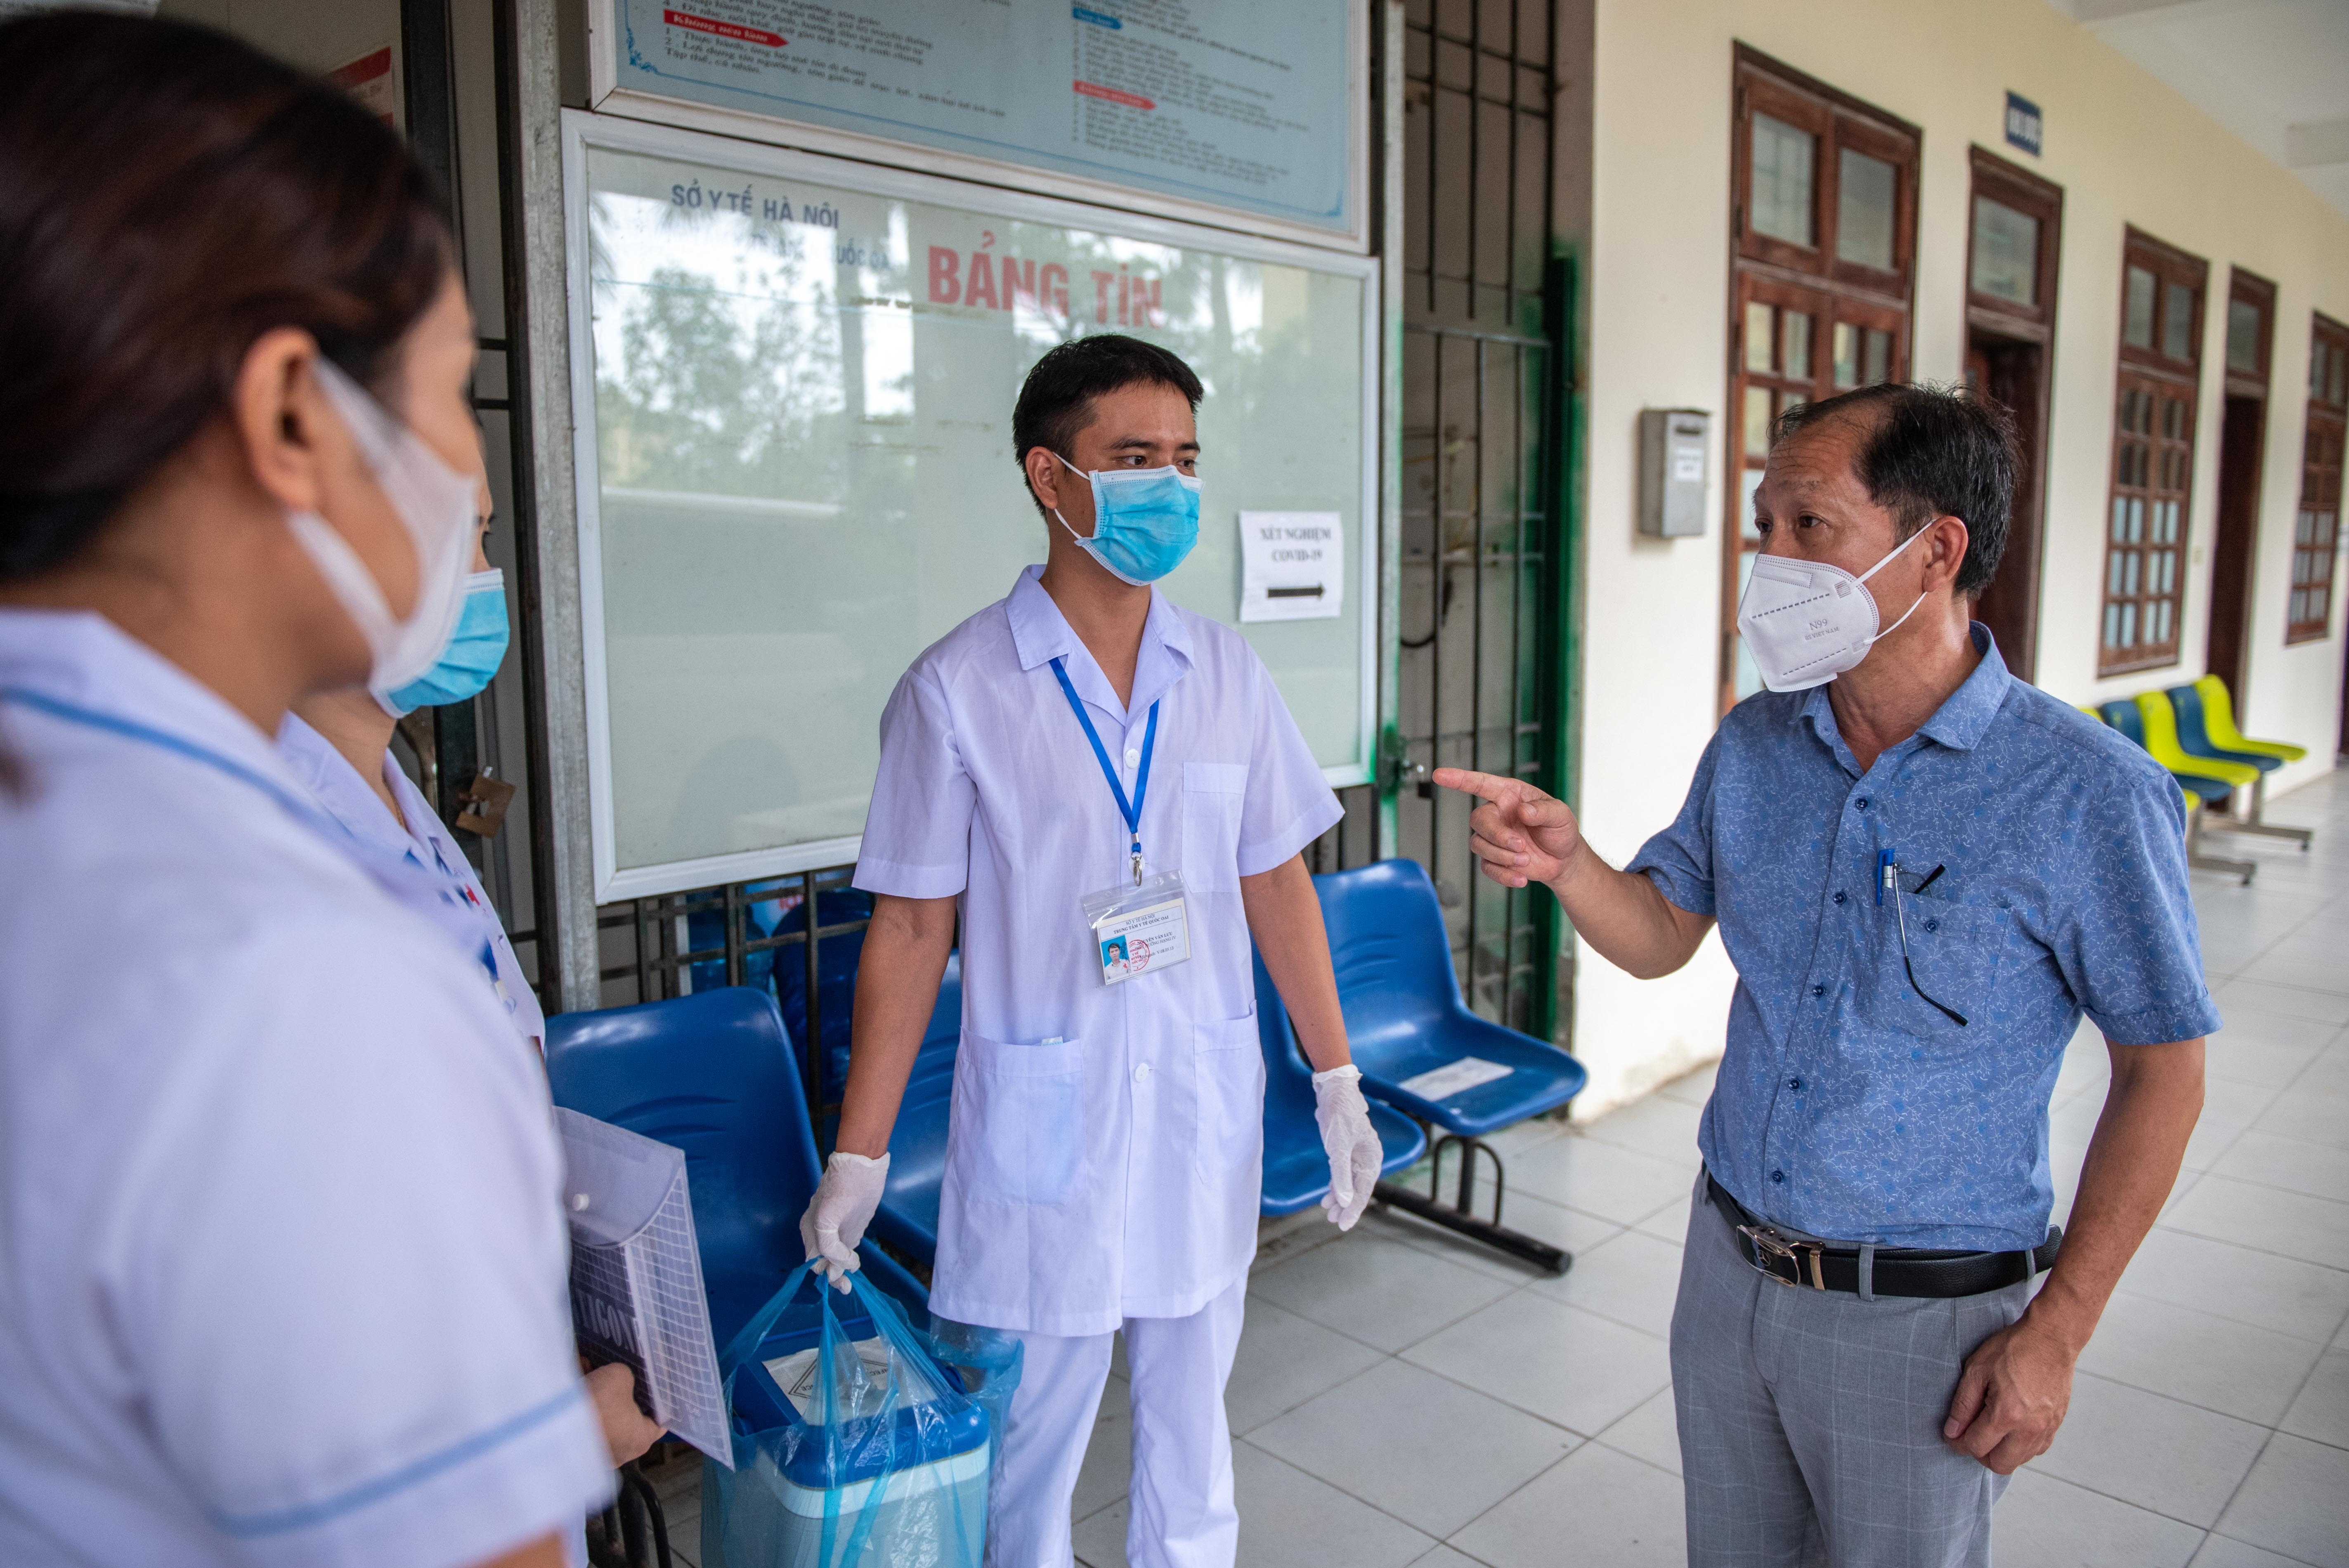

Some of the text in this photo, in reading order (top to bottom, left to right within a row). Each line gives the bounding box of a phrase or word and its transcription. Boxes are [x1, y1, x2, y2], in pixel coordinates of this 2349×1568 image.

[708, 189, 723, 211] Y
[727, 184, 753, 217] TẾ
[763, 196, 794, 222] HÀ
[928, 230, 1070, 318] BẢNG
[1809, 619, 1827, 630] N99
